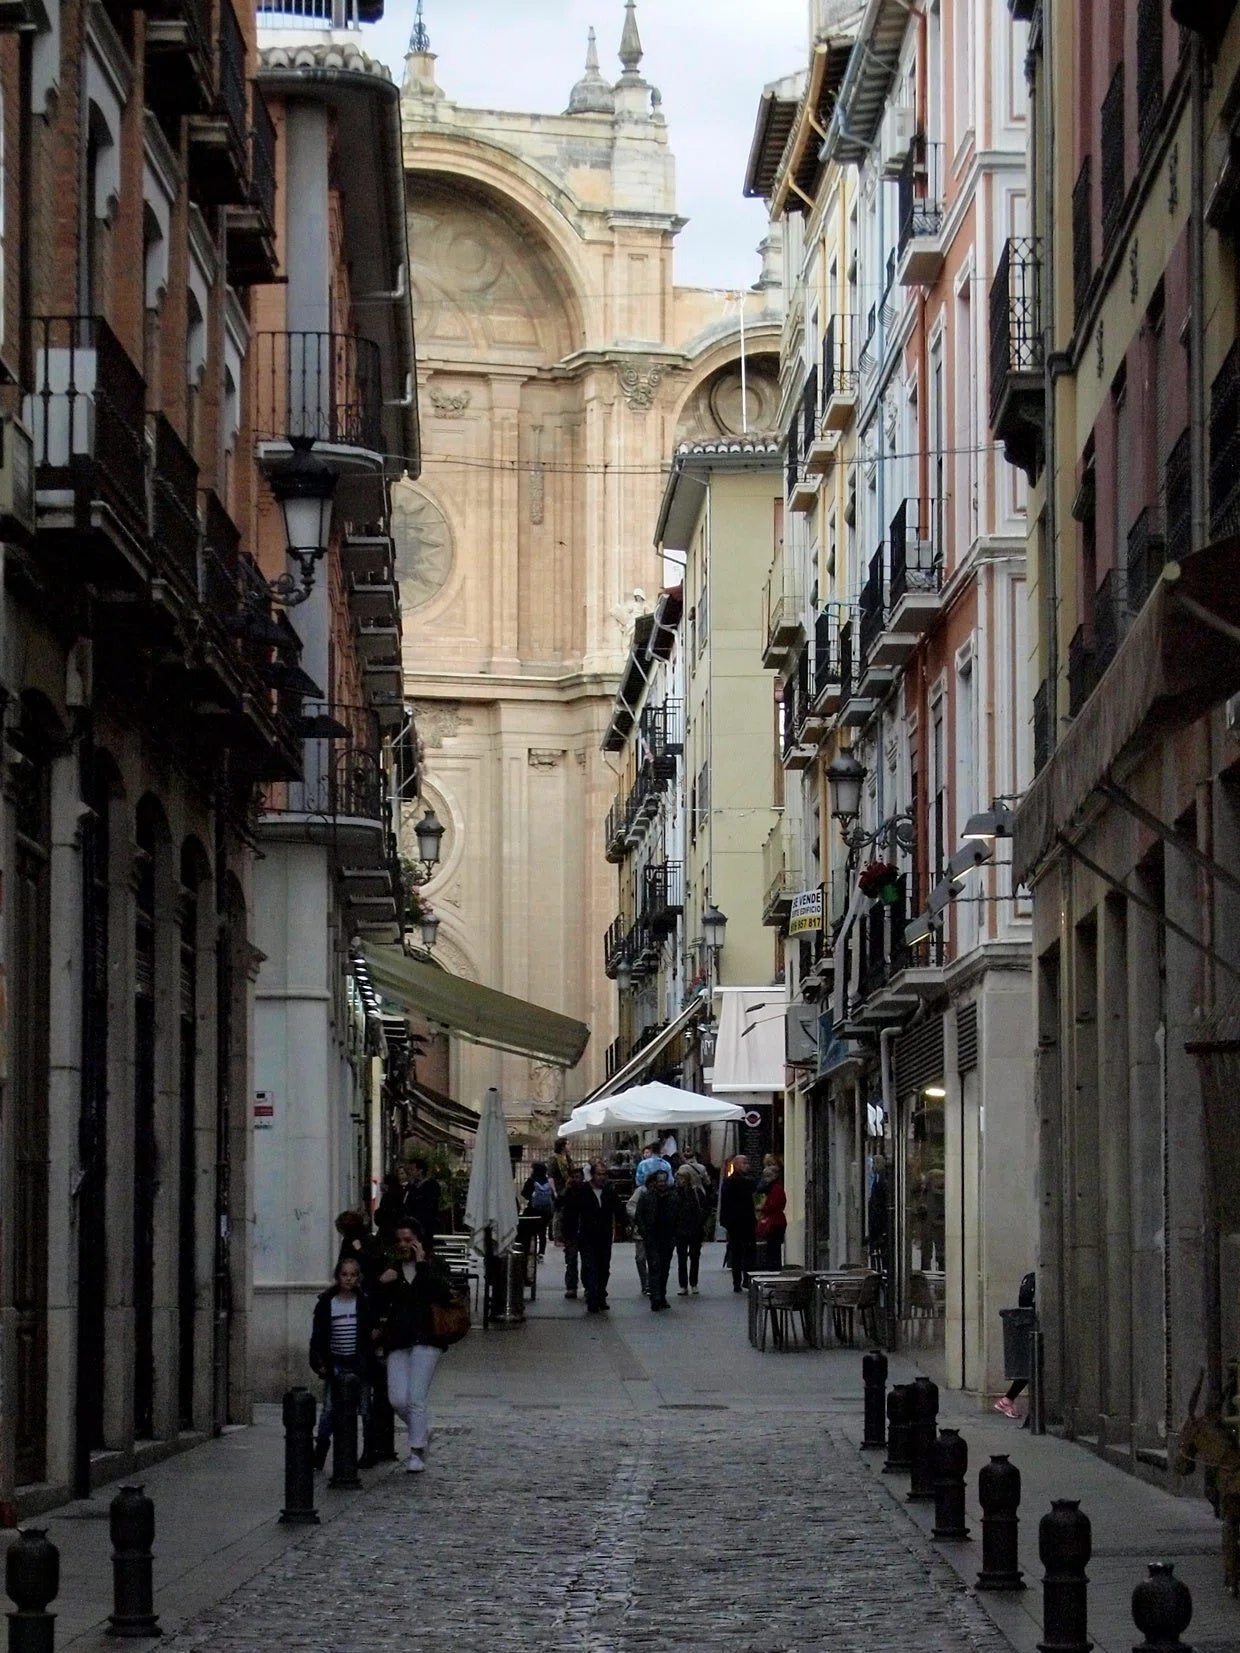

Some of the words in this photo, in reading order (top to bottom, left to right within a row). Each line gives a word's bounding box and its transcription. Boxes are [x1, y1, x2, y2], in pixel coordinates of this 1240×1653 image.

[799, 892, 821, 906] VENDE
[800, 905, 821, 915] EDIFICIO
[808, 917, 821, 928] 817
